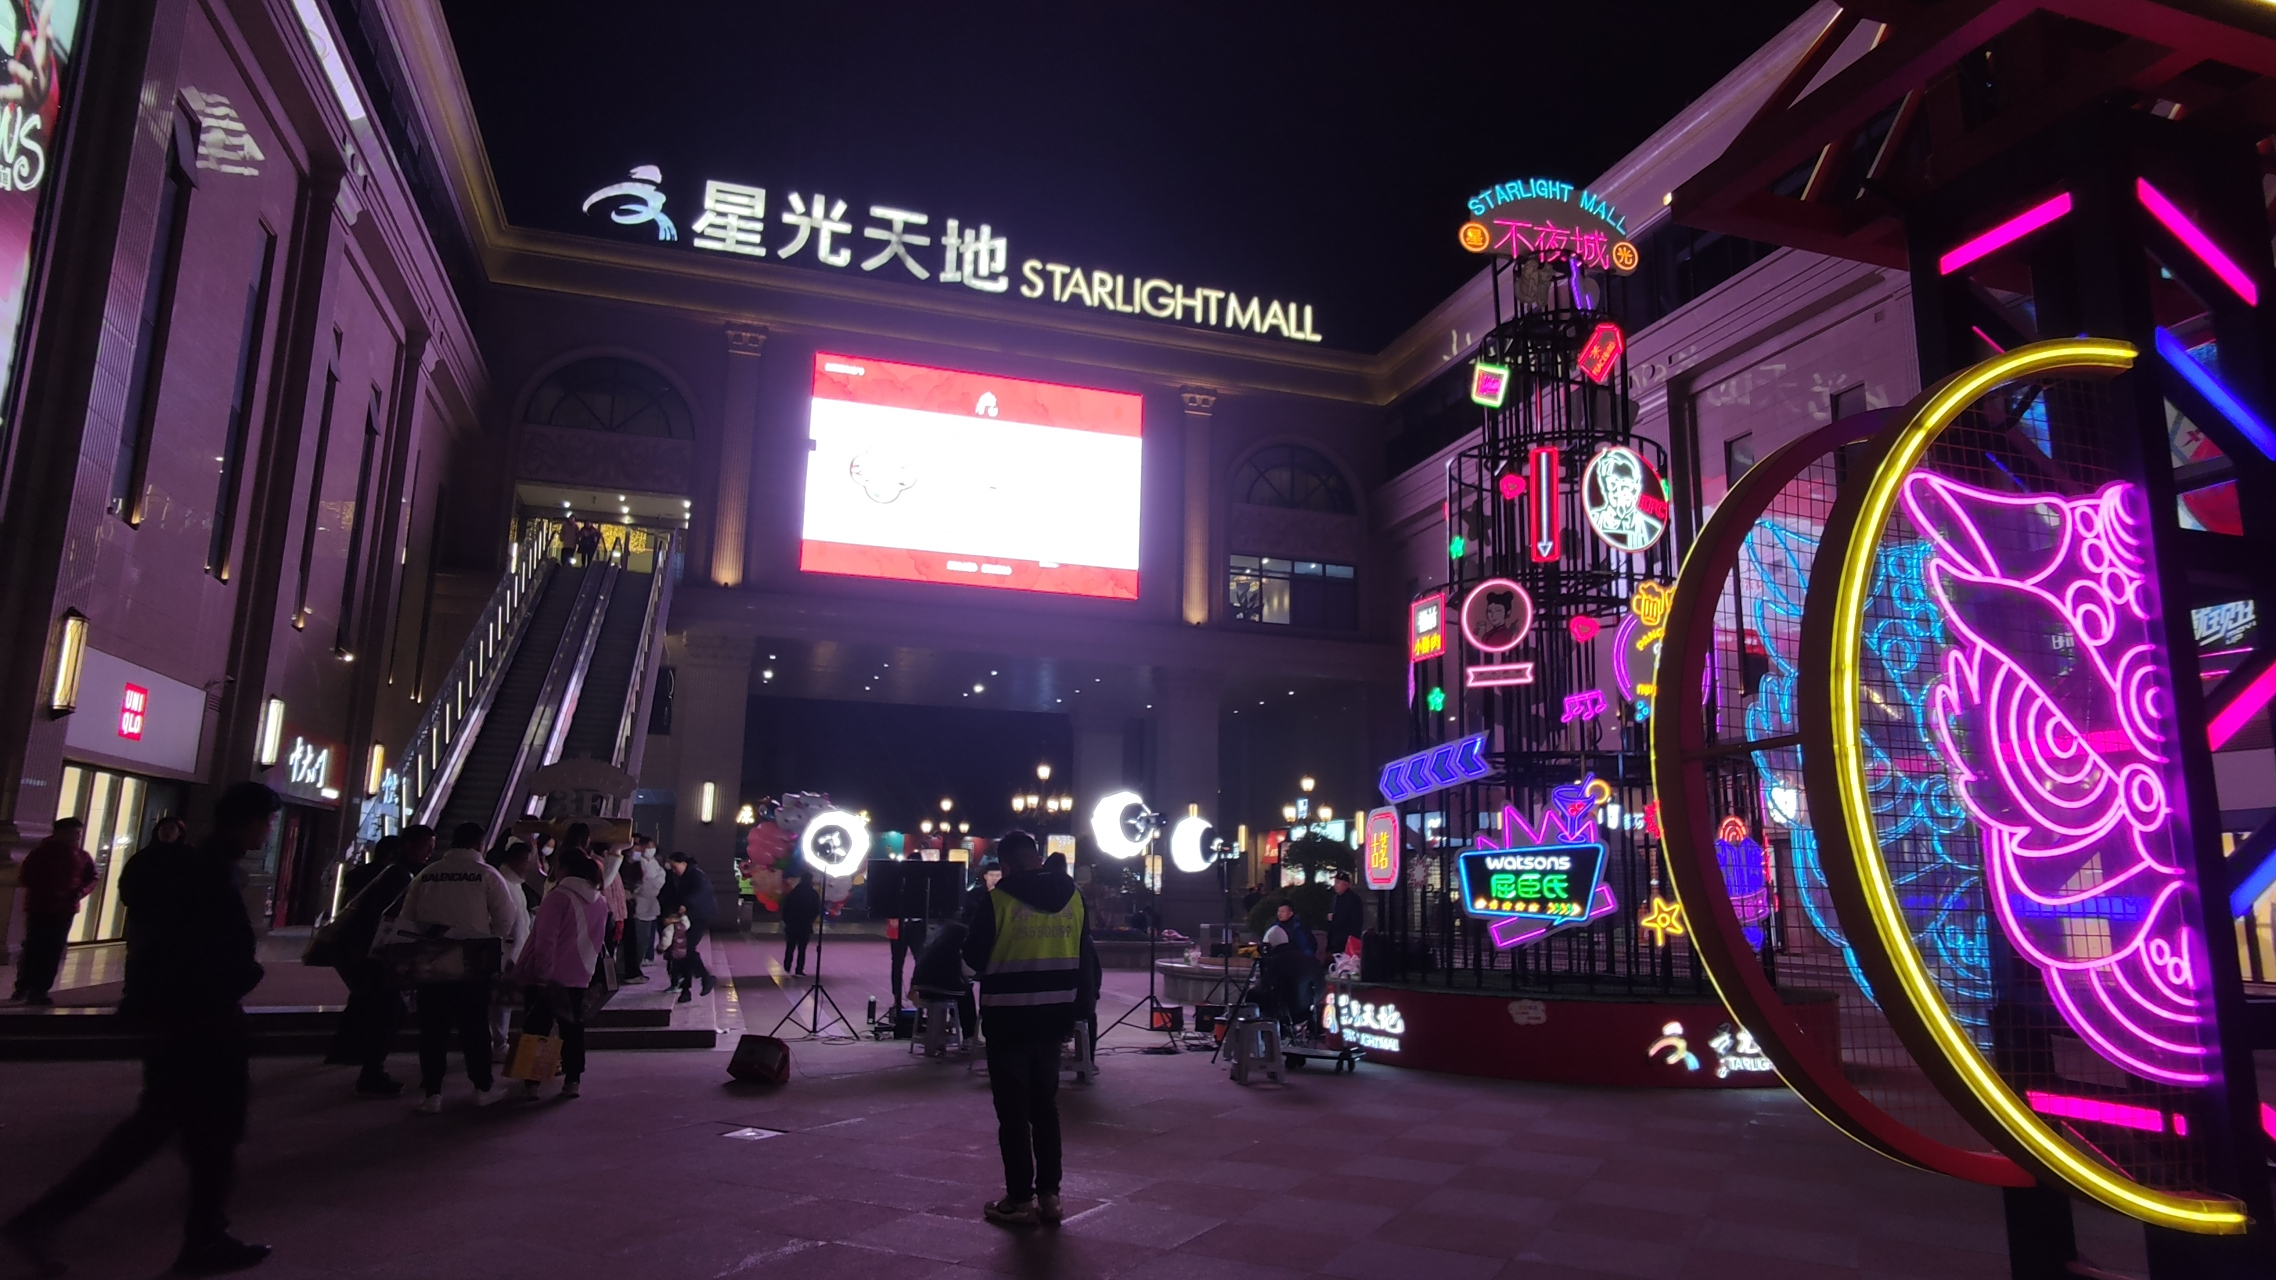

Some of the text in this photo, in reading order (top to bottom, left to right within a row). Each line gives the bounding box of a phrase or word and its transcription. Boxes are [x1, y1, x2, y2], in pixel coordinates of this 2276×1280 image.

[1467, 177, 1628, 236] STARLIGHT MALL
[691, 179, 1009, 294] 星光天地
[1493, 219, 1612, 271] 不夜城
[1637, 493, 1668, 519] KFC
[125, 689, 146, 713] UNI
[1485, 855, 1572, 871] watsons
[421, 872, 483, 883] BALENCIAGA
[1490, 873, 1568, 899] 屈臣氏
